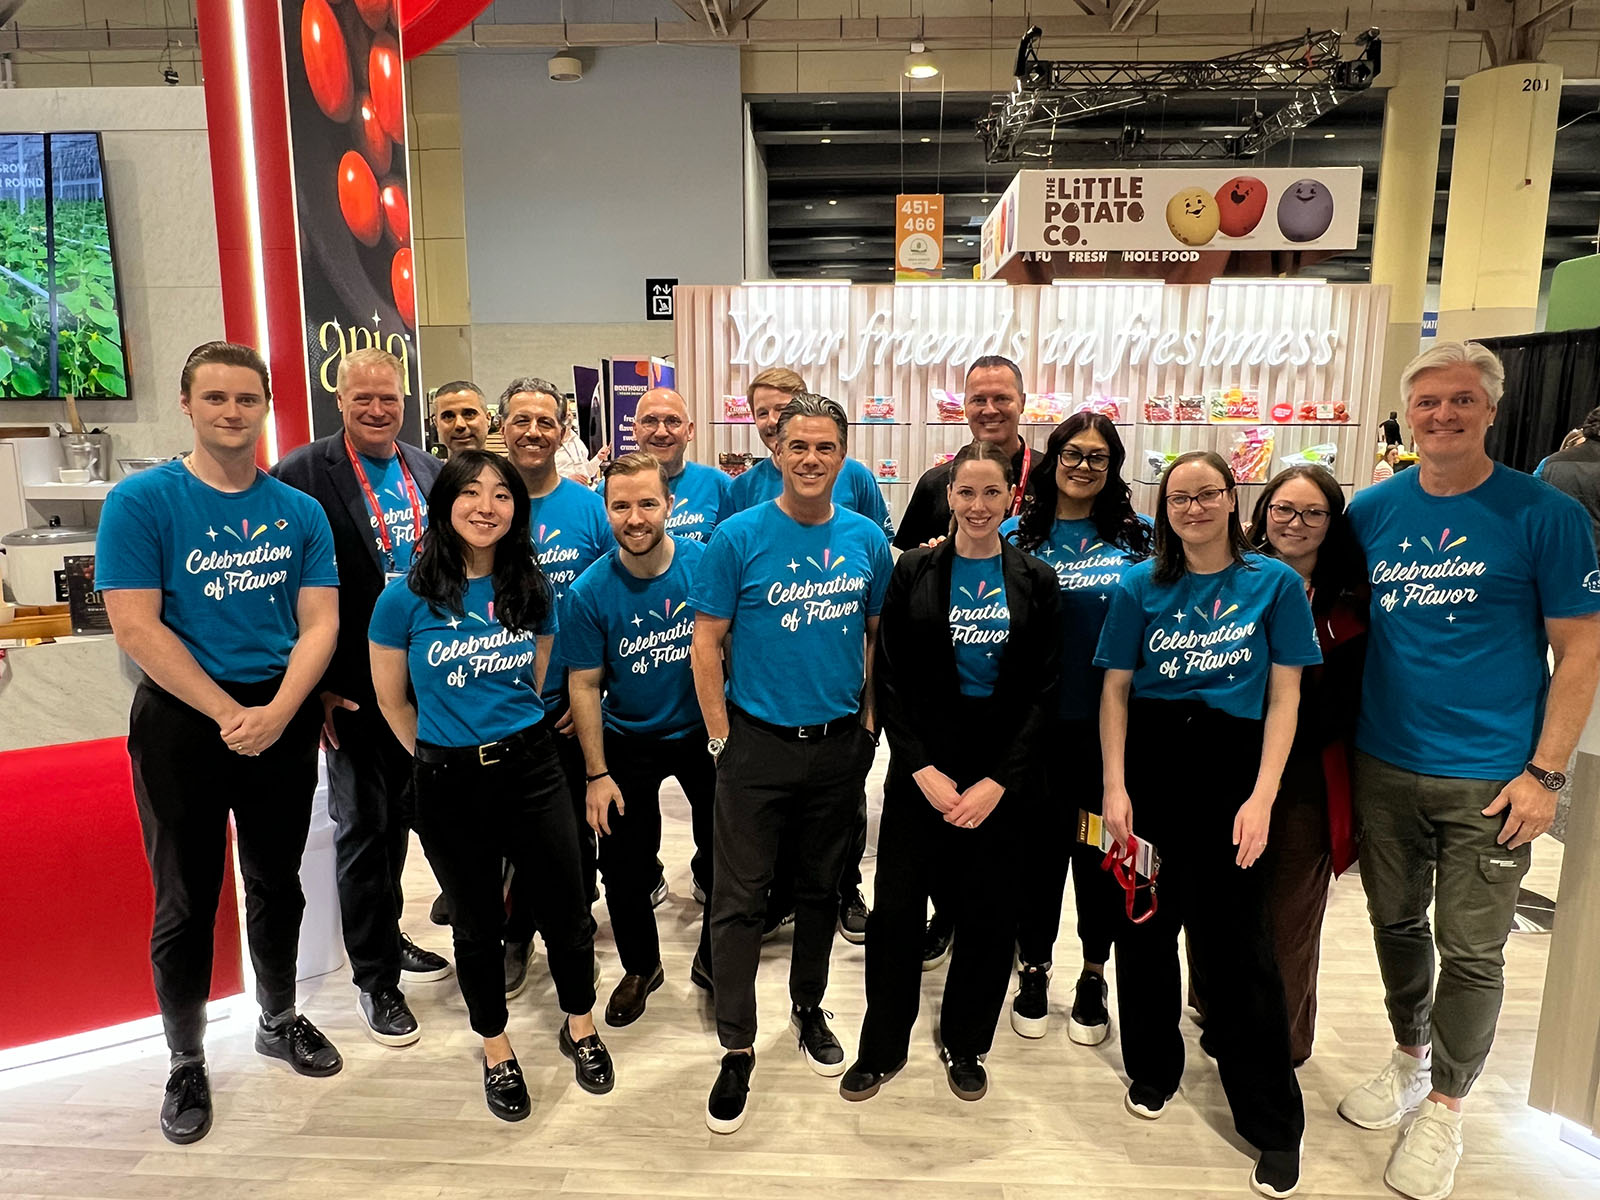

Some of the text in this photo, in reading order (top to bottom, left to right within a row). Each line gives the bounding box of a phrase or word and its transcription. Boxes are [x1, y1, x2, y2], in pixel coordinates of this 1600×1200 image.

[1522, 78, 1549, 91] 201
[5, 178, 43, 187] ROUND
[1046, 177, 1056, 199] THE
[902, 201, 937, 214] 451-
[1045, 202, 1145, 223] POTATO
[904, 217, 935, 231] 466
[1043, 225, 1088, 246] CO.
[1035, 252, 1051, 262] FU
[1069, 252, 1107, 262] FRESH
[1162, 252, 1200, 262] FOOD
[729, 309, 1337, 382] Your friends in freshness
[185, 542, 292, 575] Celebration
[1372, 556, 1486, 584] Celebration
[204, 569, 288, 601] of Flavor
[767, 572, 865, 606] Celebration
[1380, 583, 1478, 612] of Flavor
[781, 599, 859, 632] of Flavor
[619, 617, 695, 657] Celebratio
[1149, 621, 1256, 653] Celebration
[447, 651, 535, 688] of Flavor
[632, 644, 692, 674] of Flav
[1159, 647, 1252, 678] of Flavor
